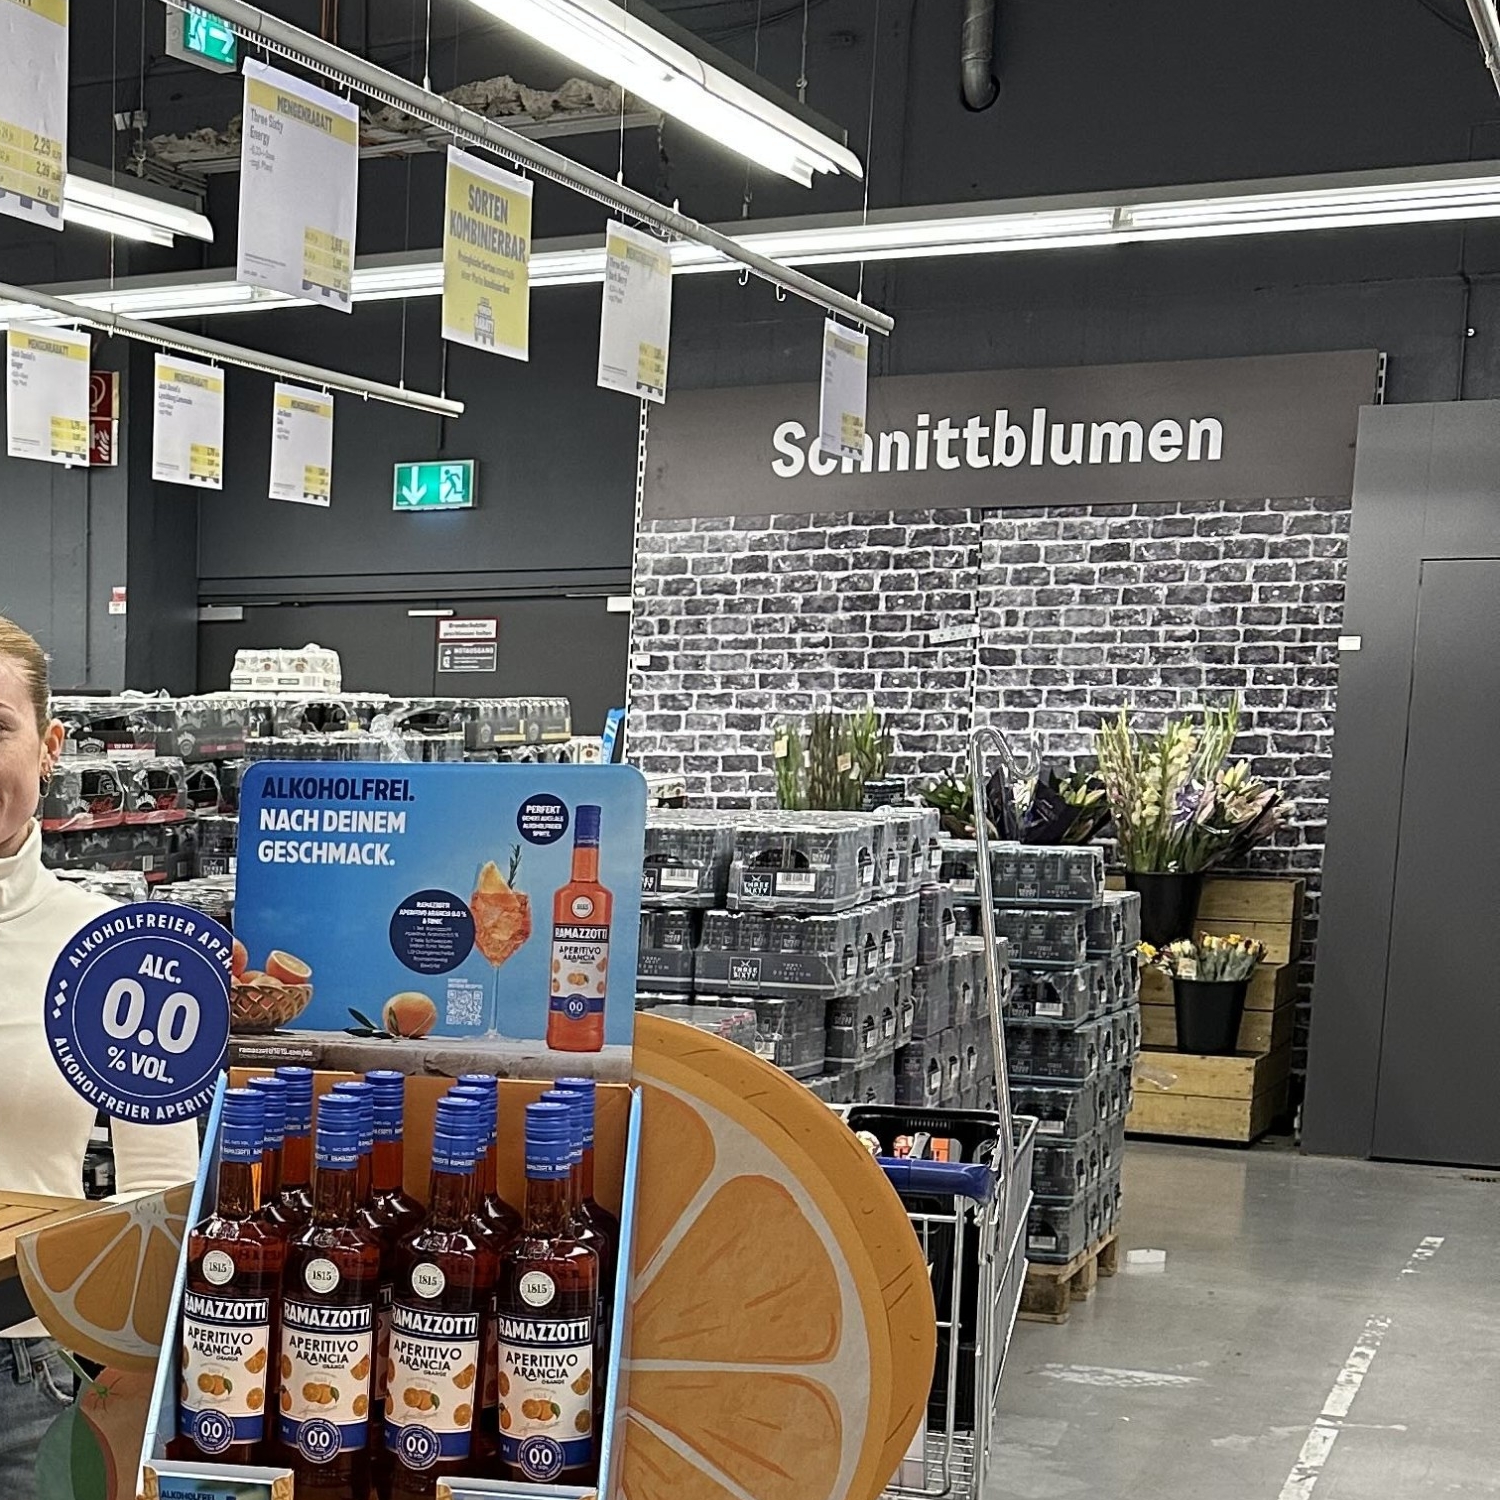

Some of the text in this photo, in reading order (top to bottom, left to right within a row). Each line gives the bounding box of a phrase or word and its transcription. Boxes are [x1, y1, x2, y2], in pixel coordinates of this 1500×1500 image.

[250, 126, 270, 147] Energy
[468, 184, 509, 225] SORTEN
[450, 209, 526, 265] KOMBINIERBAR
[261, 776, 415, 802] ALKOHOLFREI.
[525, 804, 561, 815] PERFEKT
[260, 808, 406, 835] NACH DEINEM
[258, 839, 396, 867] GESCHMACK.
[68, 913, 196, 969] ALKOHOLFREIER
[559, 945, 601, 956] APERITIVO
[138, 953, 182, 985] ALC.
[102, 977, 200, 1054] 0.0
[107, 1046, 175, 1085] % VOL.
[54, 1036, 150, 1120] ALKOHOLFREIER
[209, 1261, 227, 1272] 1815
[312, 1270, 332, 1282] 1815
[418, 1274, 438, 1286] 1815
[527, 1283, 548, 1294] 1815
[284, 1302, 370, 1328] RAMAZZOTTI
[392, 1306, 476, 1335] RAMAZZOTTI
[188, 1325, 253, 1346] APERITIVO
[499, 1319, 589, 1342] RAMAZZOTTI
[193, 1343, 242, 1357] ARANCIA
[289, 1334, 358, 1353] APERITIVO
[393, 1340, 462, 1361] APERITIVO
[296, 1350, 349, 1366] ARANCIA
[399, 1354, 451, 1371] ARANCIA
[505, 1351, 578, 1367] APERITIVO
[513, 1365, 569, 1381] ARANCIA
